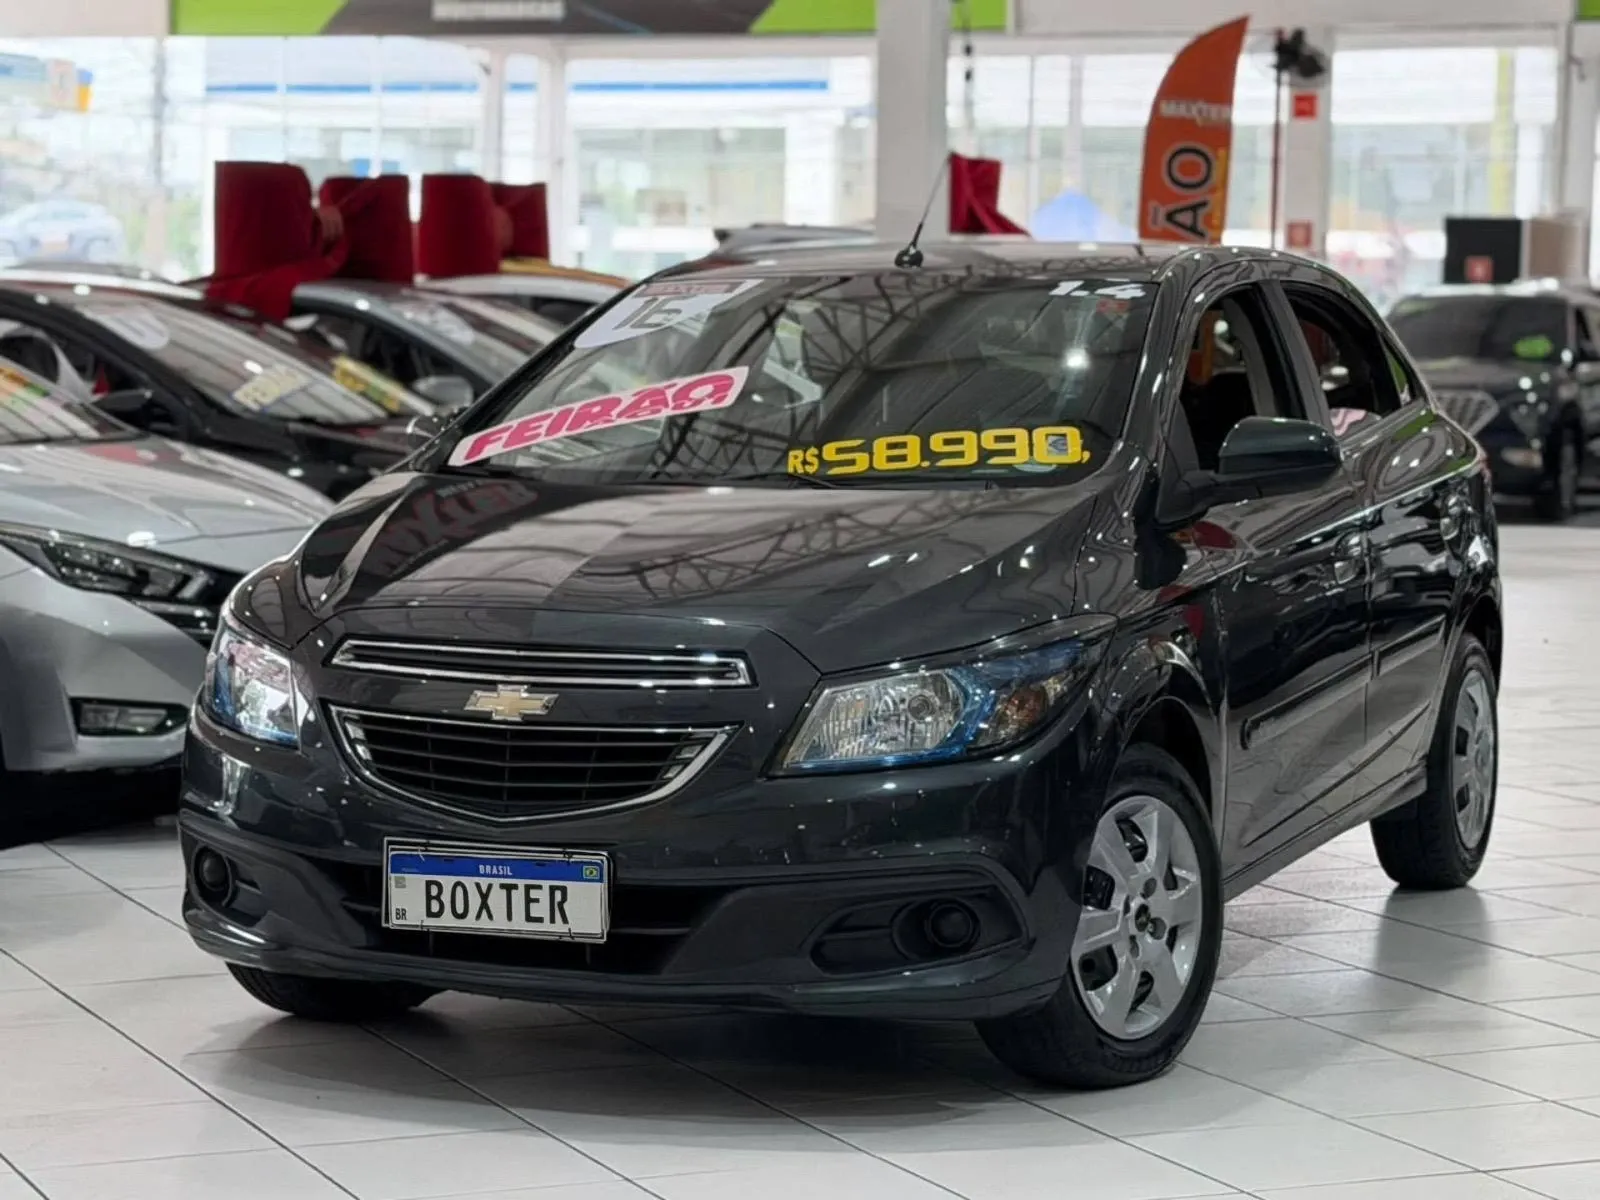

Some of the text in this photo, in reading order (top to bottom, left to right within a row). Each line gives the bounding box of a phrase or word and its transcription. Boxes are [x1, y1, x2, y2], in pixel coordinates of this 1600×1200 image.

[1048, 280, 1146, 300] 1.4
[463, 374, 735, 461] FEIRÃO
[478, 864, 513, 876] BRASIL
[425, 879, 569, 925] BOXTER
[394, 907, 407, 921] BR
